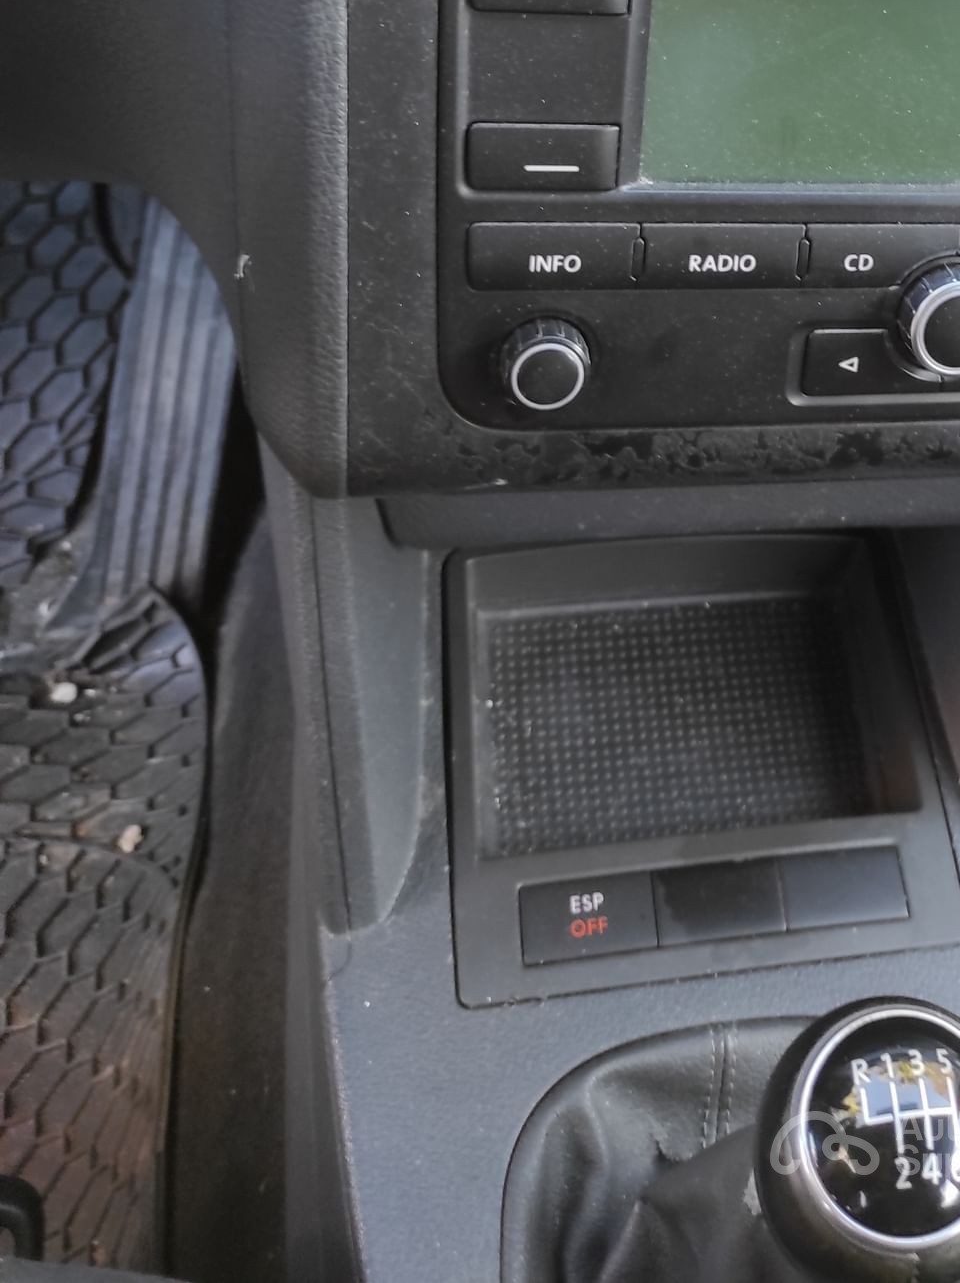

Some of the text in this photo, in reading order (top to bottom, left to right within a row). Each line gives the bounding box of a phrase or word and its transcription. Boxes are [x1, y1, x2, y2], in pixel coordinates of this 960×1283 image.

[528, 253, 582, 273] INFO
[688, 253, 757, 273] RADIO
[843, 253, 874, 272] CD
[569, 891, 605, 915] ESP
[569, 916, 608, 939] OFF
[850, 1047, 953, 1086] R 1 3 5
[894, 1156, 913, 1190] 2
[921, 1152, 943, 1185] 4
